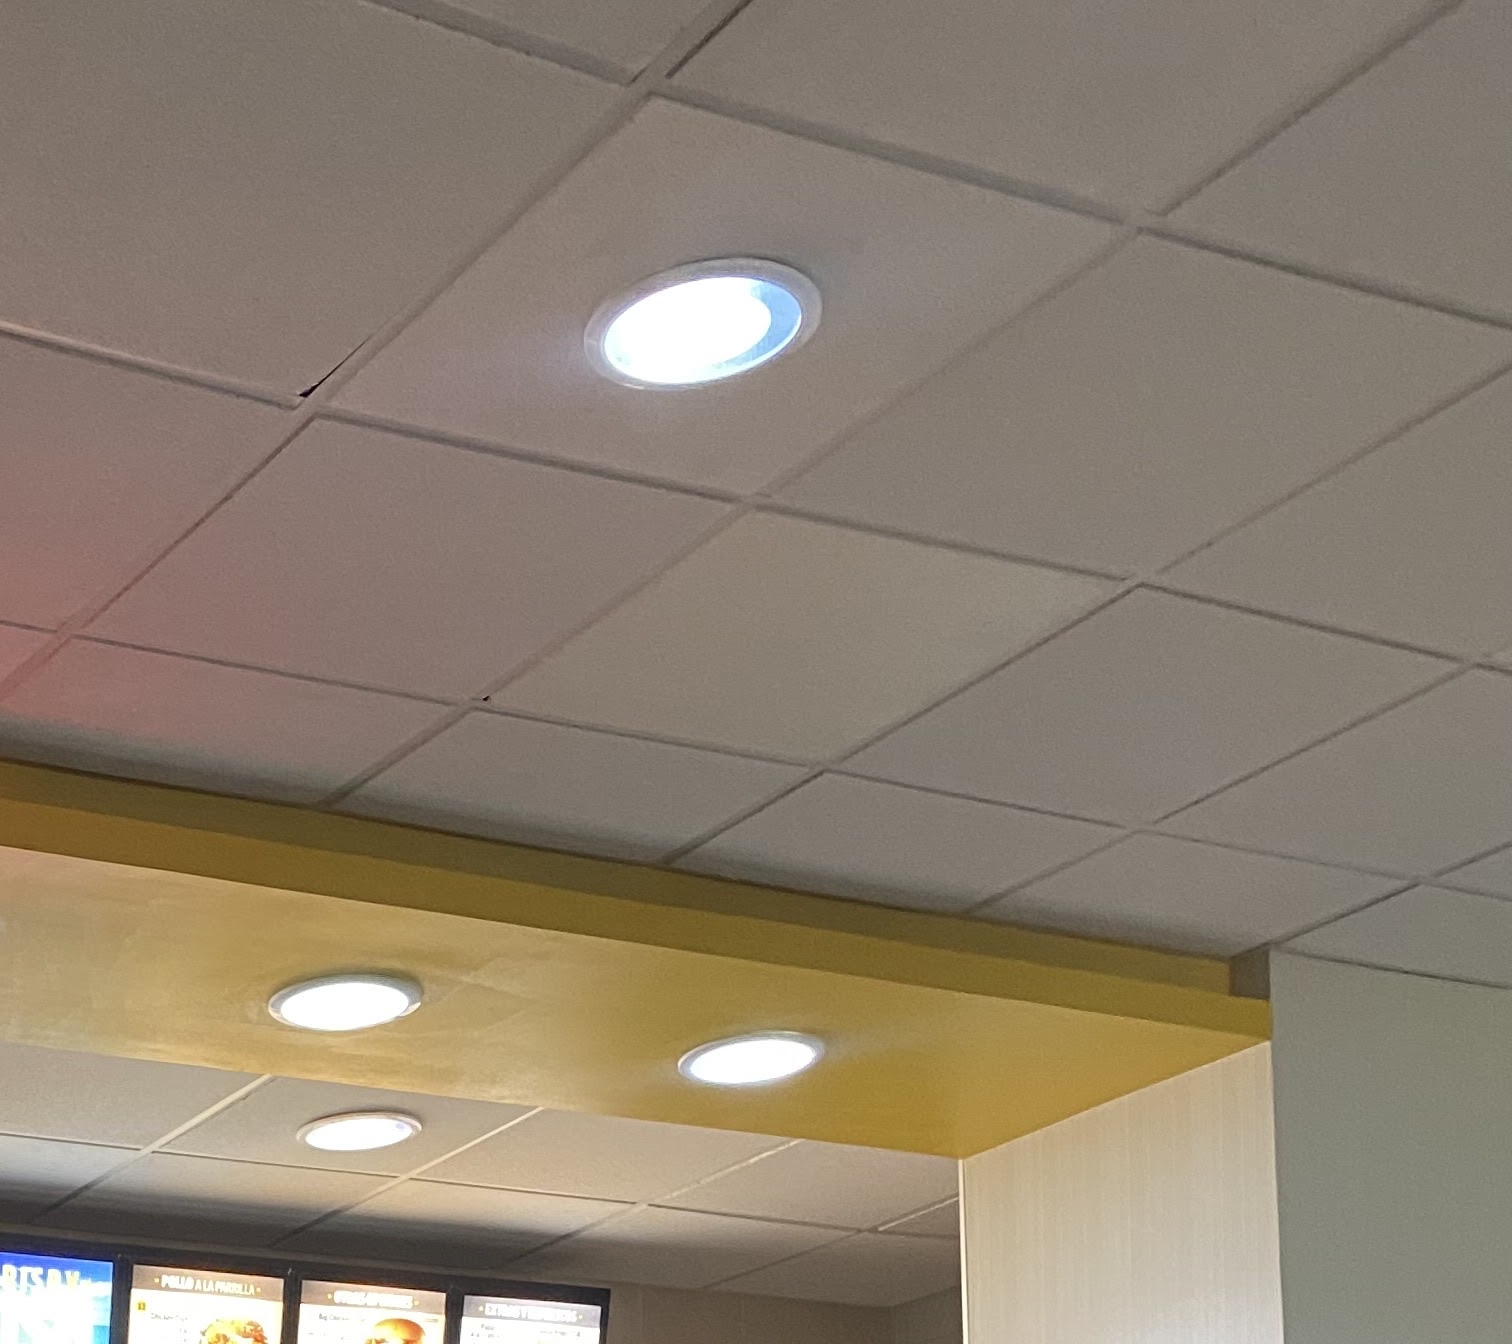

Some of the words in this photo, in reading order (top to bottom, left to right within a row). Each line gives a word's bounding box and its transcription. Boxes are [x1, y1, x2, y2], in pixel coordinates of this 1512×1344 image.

[161, 1274, 195, 1291] POLLO
[195, 1279, 203, 1291] A
[203, 1280, 215, 1292] LA
[215, 1281, 256, 1296] PARRILLA
